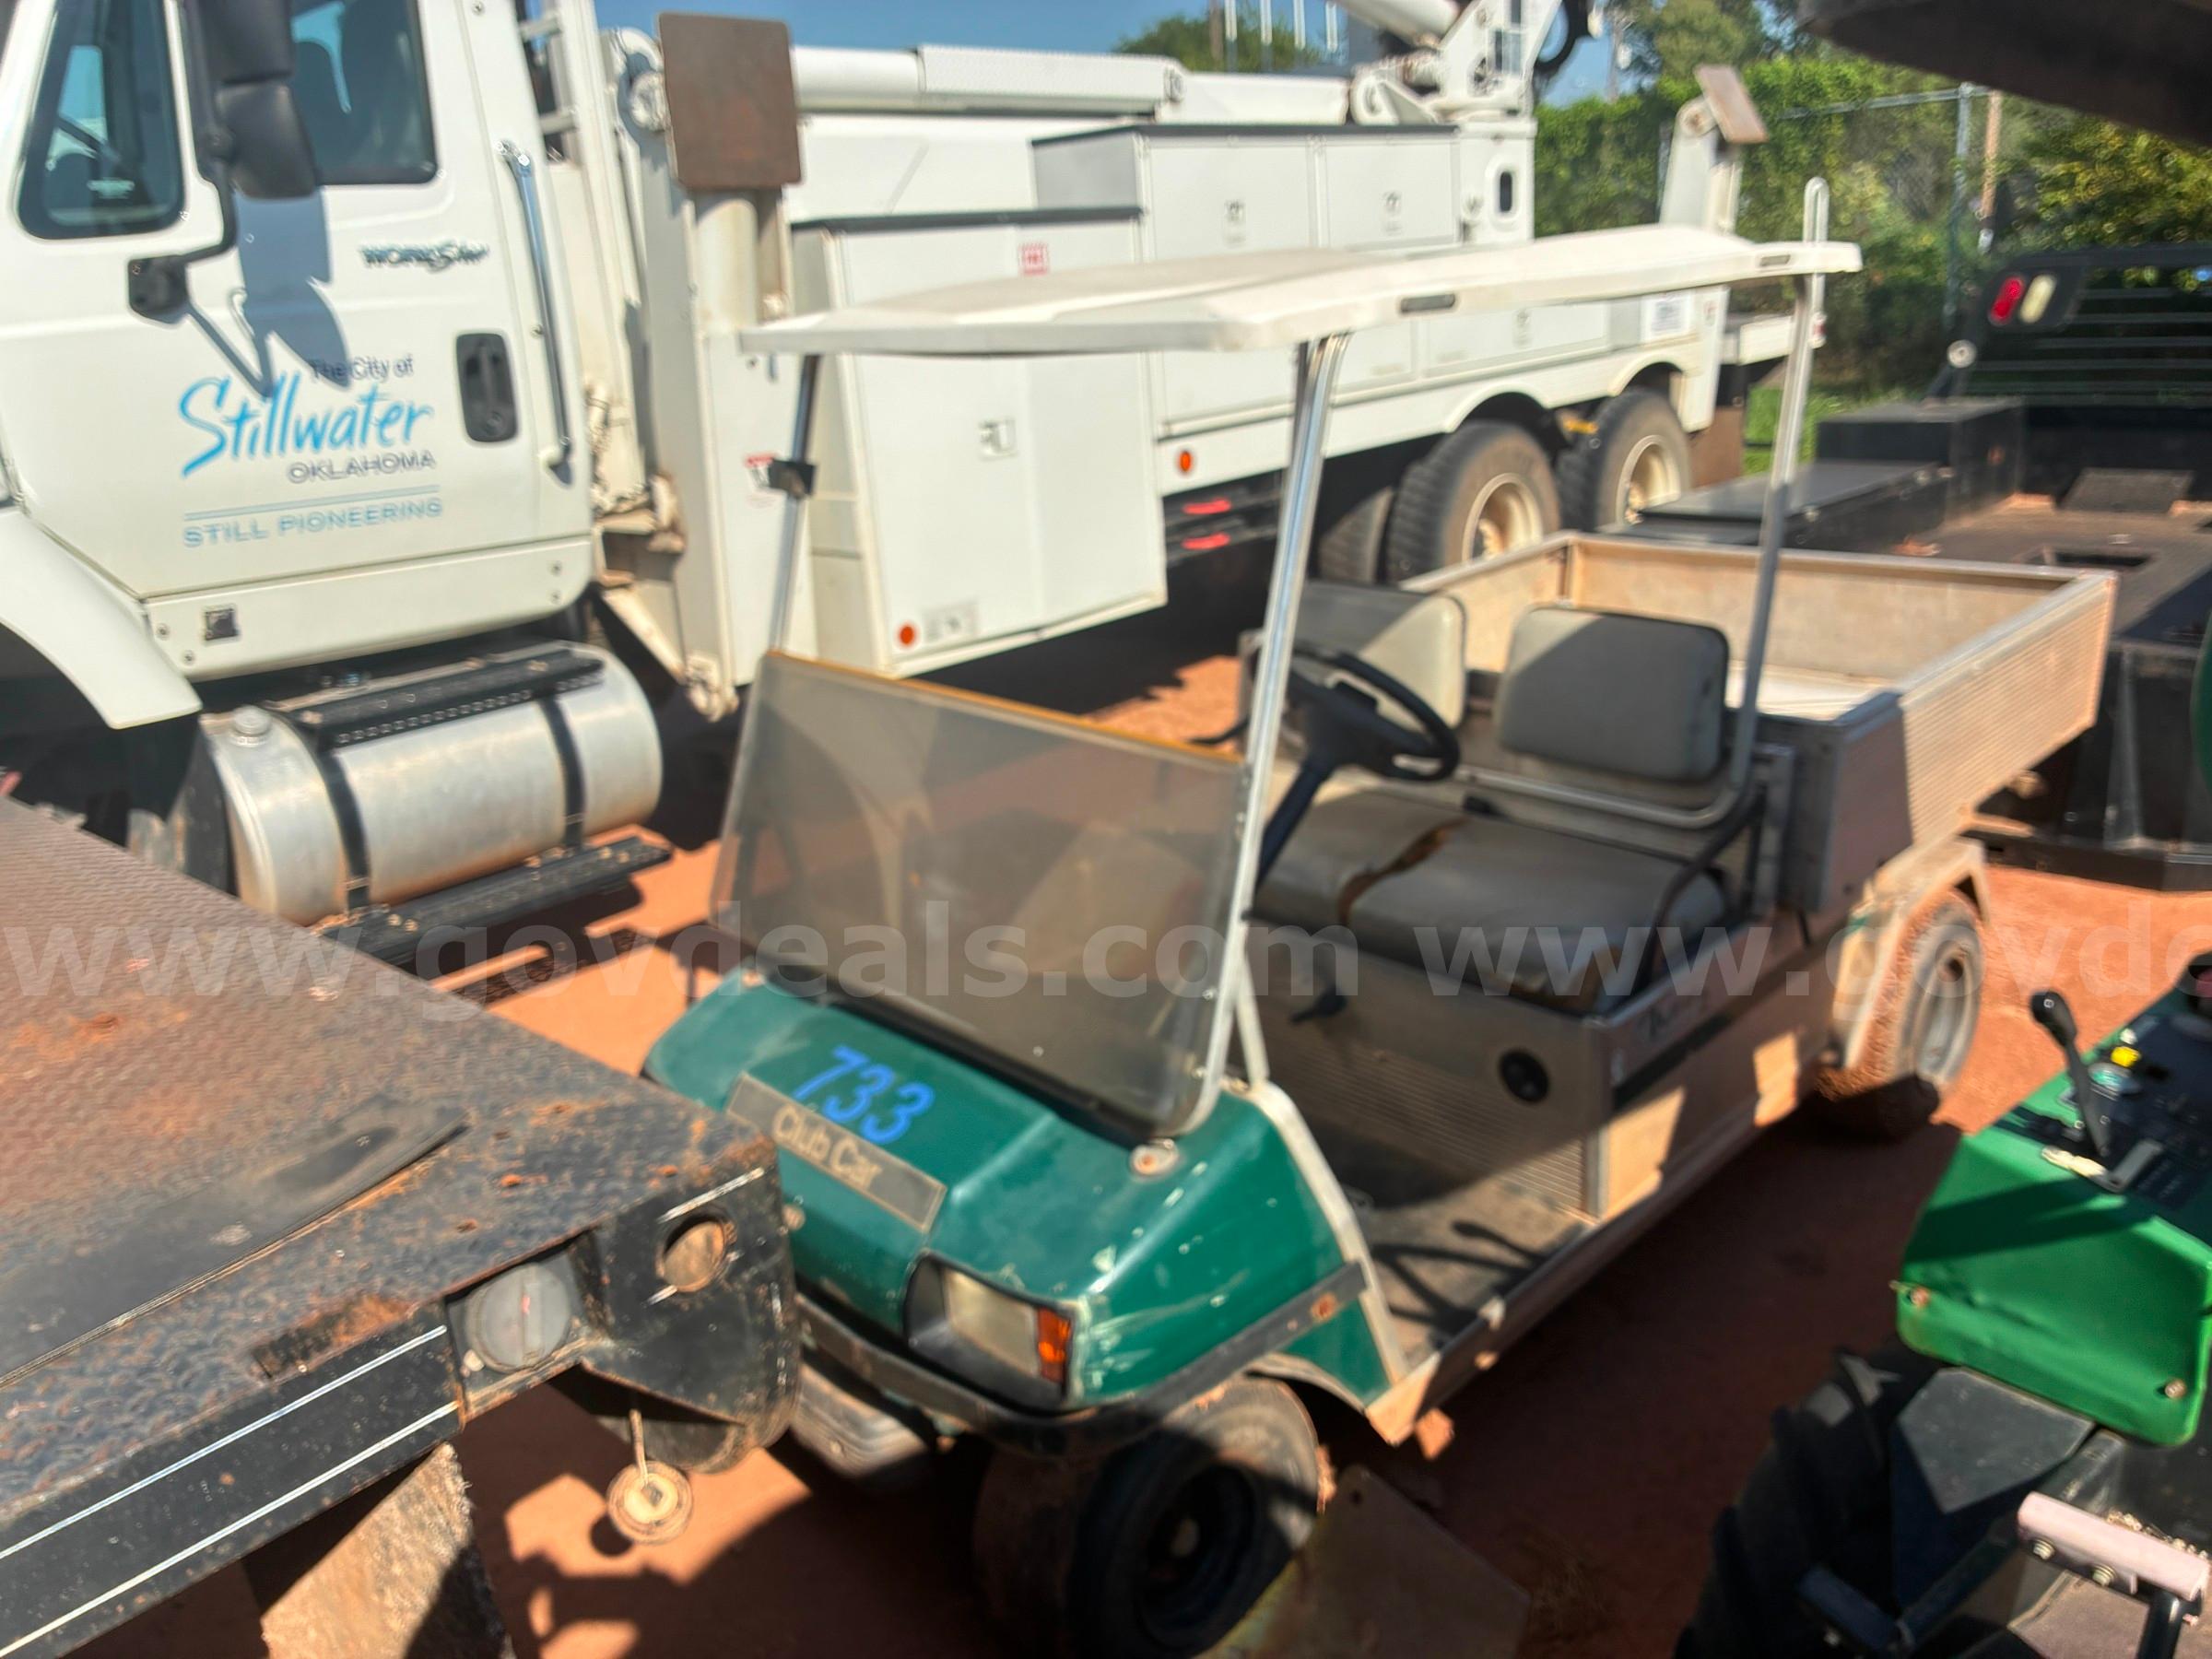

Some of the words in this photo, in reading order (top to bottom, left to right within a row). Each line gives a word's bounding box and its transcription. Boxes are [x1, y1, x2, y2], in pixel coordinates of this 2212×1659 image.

[311, 359, 350, 381] The
[351, 356, 392, 382] City
[394, 355, 415, 377] of
[178, 370, 435, 477] Stillwater
[288, 450, 437, 484] OKLAHOMA
[183, 519, 269, 548] STILL
[278, 498, 444, 535] PIONEERING
[794, 1046, 934, 1144] 733
[771, 1104, 831, 1158] Club
[829, 1138, 885, 1187] Car
